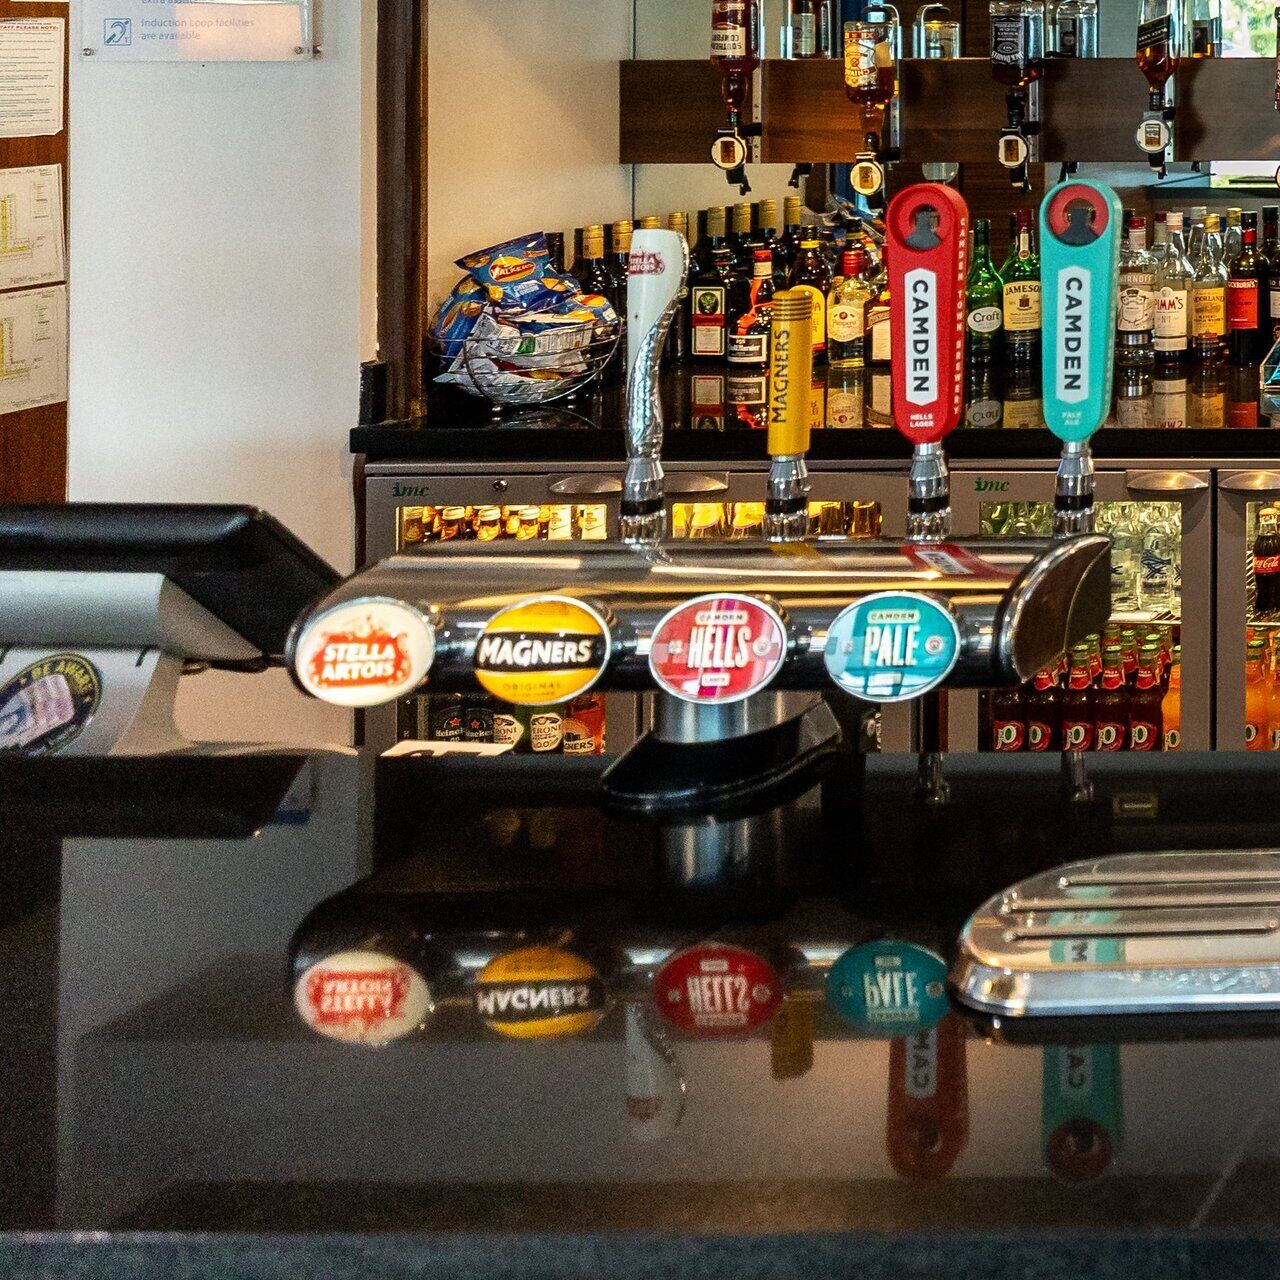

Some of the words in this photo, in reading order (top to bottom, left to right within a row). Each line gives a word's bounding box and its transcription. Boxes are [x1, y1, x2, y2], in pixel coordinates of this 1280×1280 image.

[972, 309, 1000, 323] Croft
[912, 279, 929, 393] CAMDEN
[1065, 277, 1082, 391] CAMDEN
[771, 329, 790, 423] MAGNERS
[699, 613, 743, 622] CAMDEN
[871, 612, 915, 621] CAMDEN
[323, 642, 397, 662] STELLA
[479, 637, 593, 666] MAGNERS
[688, 625, 751, 669] HELLS
[864, 625, 921, 667] PALE
[321, 661, 395, 680] ARTOIS
